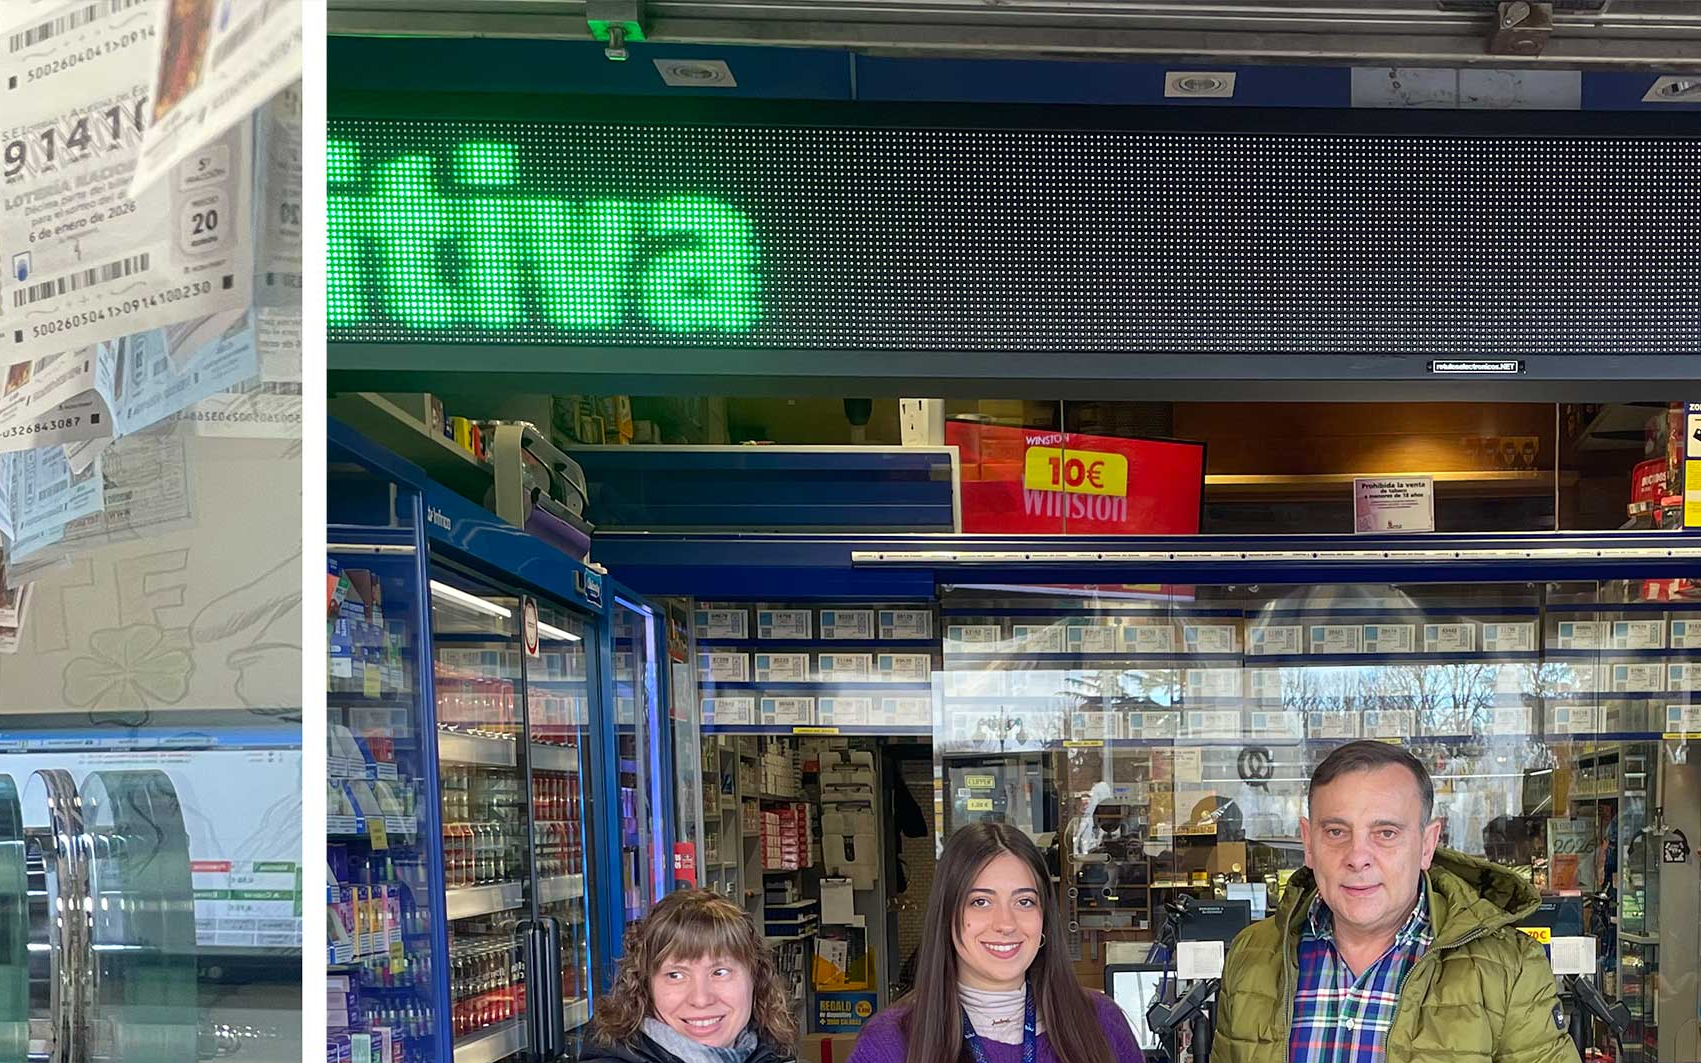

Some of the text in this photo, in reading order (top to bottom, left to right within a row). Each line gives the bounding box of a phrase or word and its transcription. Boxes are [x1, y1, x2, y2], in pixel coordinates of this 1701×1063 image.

[29, 201, 137, 243] 6 de enero de 2026
[191, 209, 219, 236] 20
[1689, 402, 1701, 411] ZO
[1026, 434, 1070, 446] WINSTON
[1048, 456, 1105, 489] 10€
[1024, 488, 1128, 522] Winston
